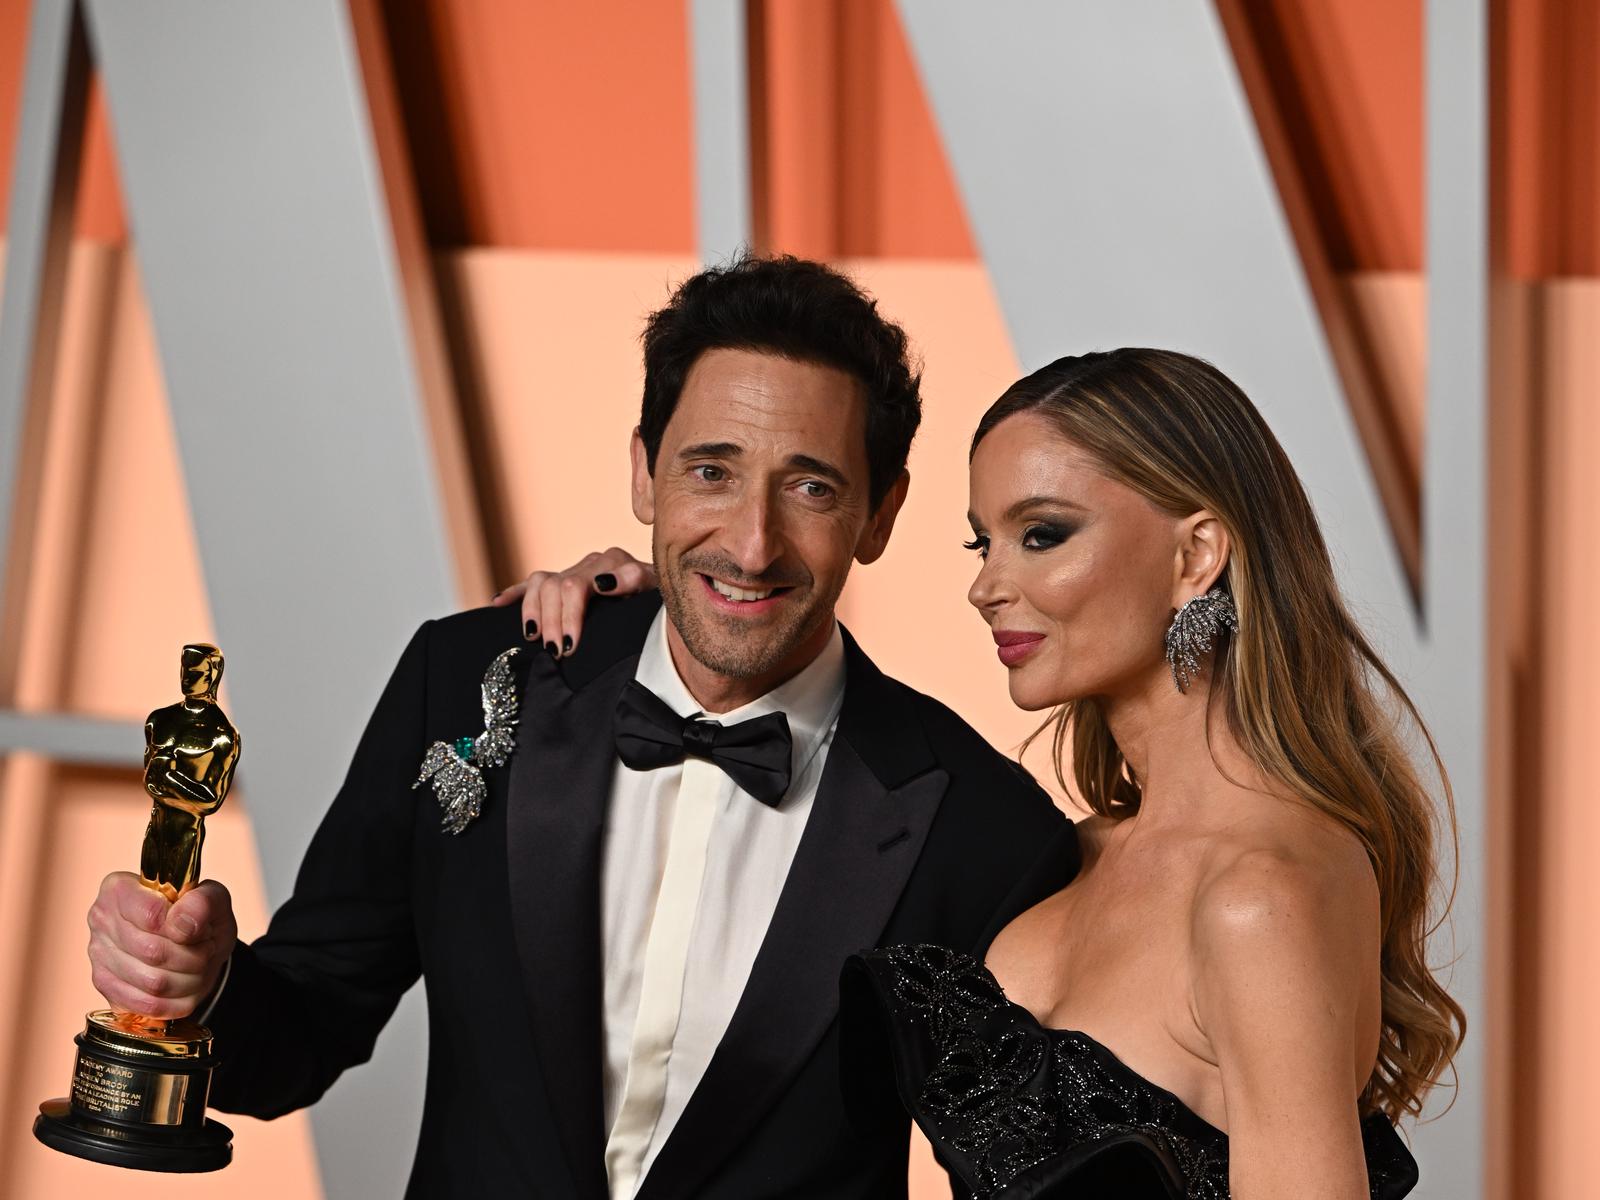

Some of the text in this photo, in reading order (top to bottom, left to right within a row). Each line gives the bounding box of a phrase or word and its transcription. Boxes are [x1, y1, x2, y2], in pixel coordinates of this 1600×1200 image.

[105, 1067, 134, 1079] AWARD
[100, 1079, 128, 1090] BRODY
[92, 1091, 120, 1103] LEADING
[120, 1098, 141, 1106] ROLE
